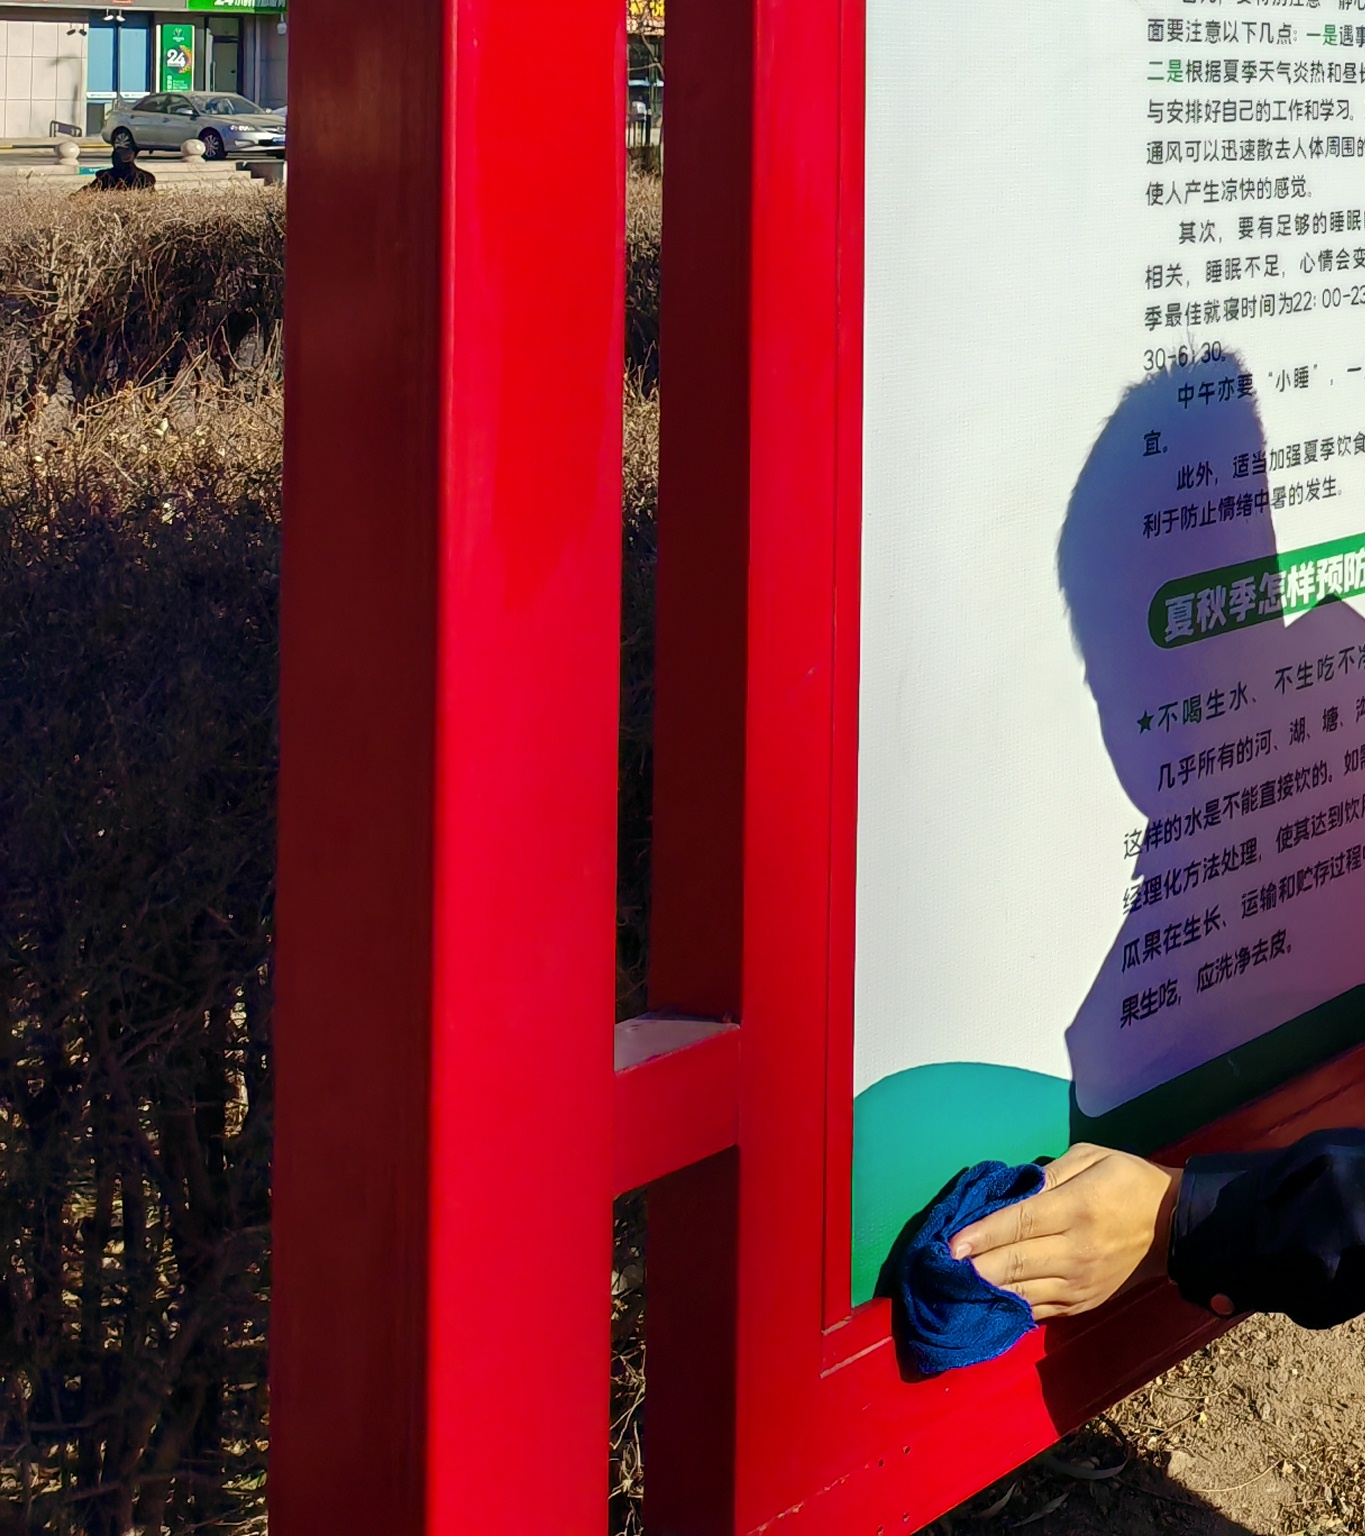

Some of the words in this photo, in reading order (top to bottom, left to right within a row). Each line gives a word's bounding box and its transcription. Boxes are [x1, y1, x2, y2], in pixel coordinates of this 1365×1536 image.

[1146, 175, 1313, 206] 使人产生凉快的感觉。
[1143, 429, 1168, 457] 宜。
[1142, 475, 1343, 540] 利于防止情绪中暑的发生。
